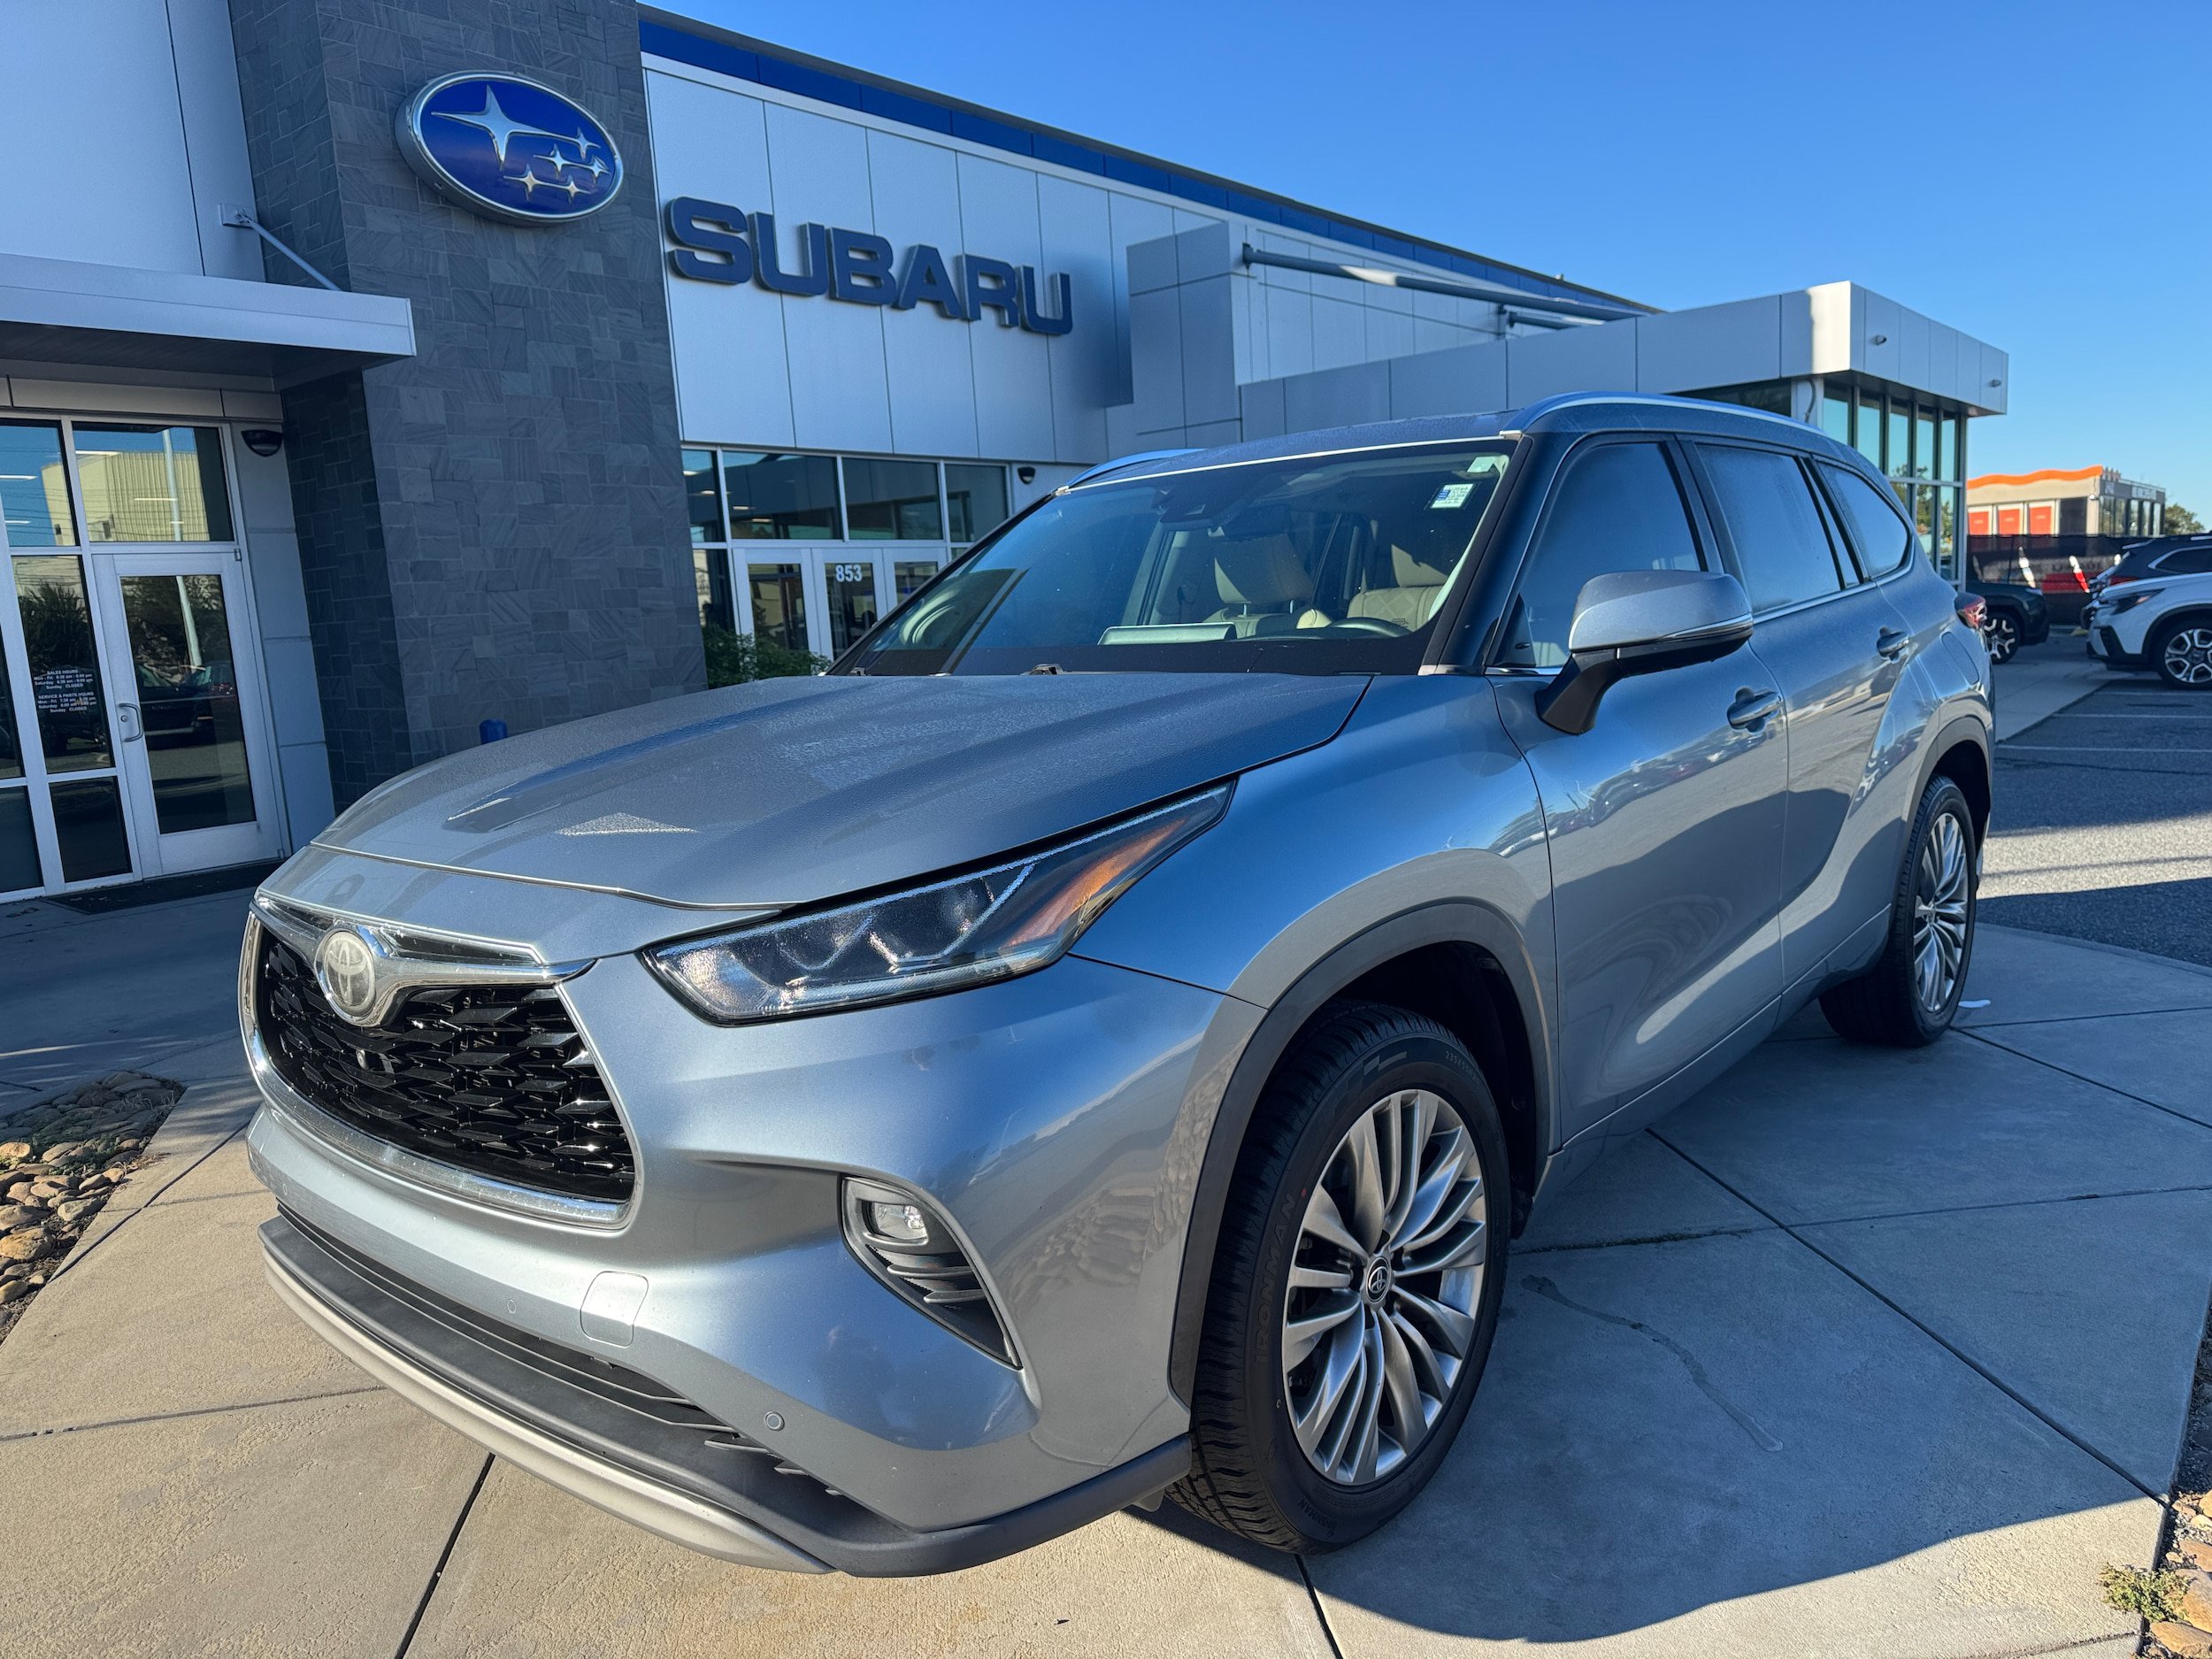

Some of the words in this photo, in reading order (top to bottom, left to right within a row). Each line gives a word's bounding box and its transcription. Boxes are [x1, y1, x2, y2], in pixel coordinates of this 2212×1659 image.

[664, 196, 1073, 335] SUBARU
[835, 564, 863, 582] 853
[1255, 1191, 1296, 1362] IRONMAN
